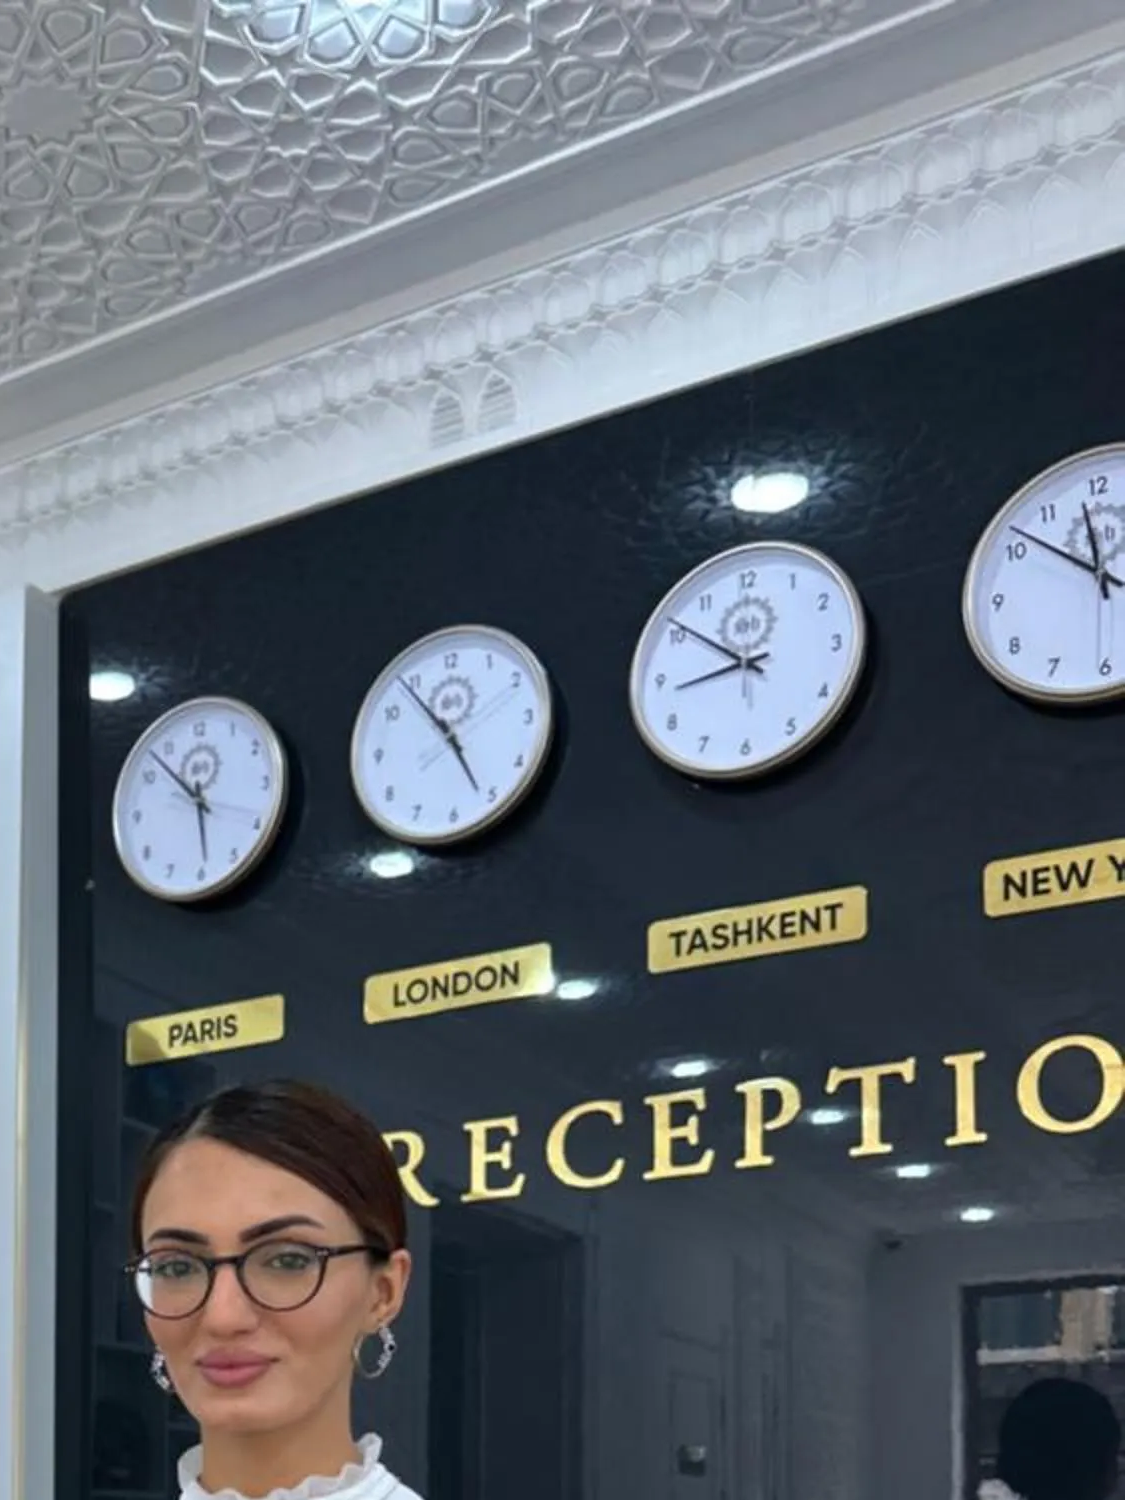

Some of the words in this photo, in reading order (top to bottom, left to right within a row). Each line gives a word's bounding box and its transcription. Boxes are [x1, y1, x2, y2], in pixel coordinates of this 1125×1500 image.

[1089, 476, 1108, 495] 12
[1040, 504, 1055, 523] 11
[1006, 542, 1026, 561] 10
[740, 571, 756, 588] 12
[700, 595, 711, 610] 11
[819, 593, 829, 611] 2
[992, 594, 1003, 611] 9
[670, 628, 685, 645] 10
[832, 634, 842, 651] 3
[1009, 637, 1020, 655] 8
[445, 653, 458, 668] 12
[1048, 658, 1060, 677] 7
[1099, 658, 1112, 676] 6
[511, 673, 521, 688] 2
[655, 674, 666, 689] 9
[818, 683, 828, 697] 4
[385, 706, 400, 721] 10
[525, 709, 533, 724] 3
[667, 714, 677, 730] 8
[785, 718, 796, 735] 5
[699, 736, 709, 752] 7
[740, 739, 750, 755] 6
[514, 755, 523, 768] 4
[488, 787, 497, 802] 5
[412, 805, 422, 821] 7
[449, 808, 458, 822] 6
[1003, 858, 1095, 901] NEW
[668, 902, 843, 957] TASHKENT
[393, 961, 519, 1008] LONDON
[168, 1014, 239, 1048] PARIS
